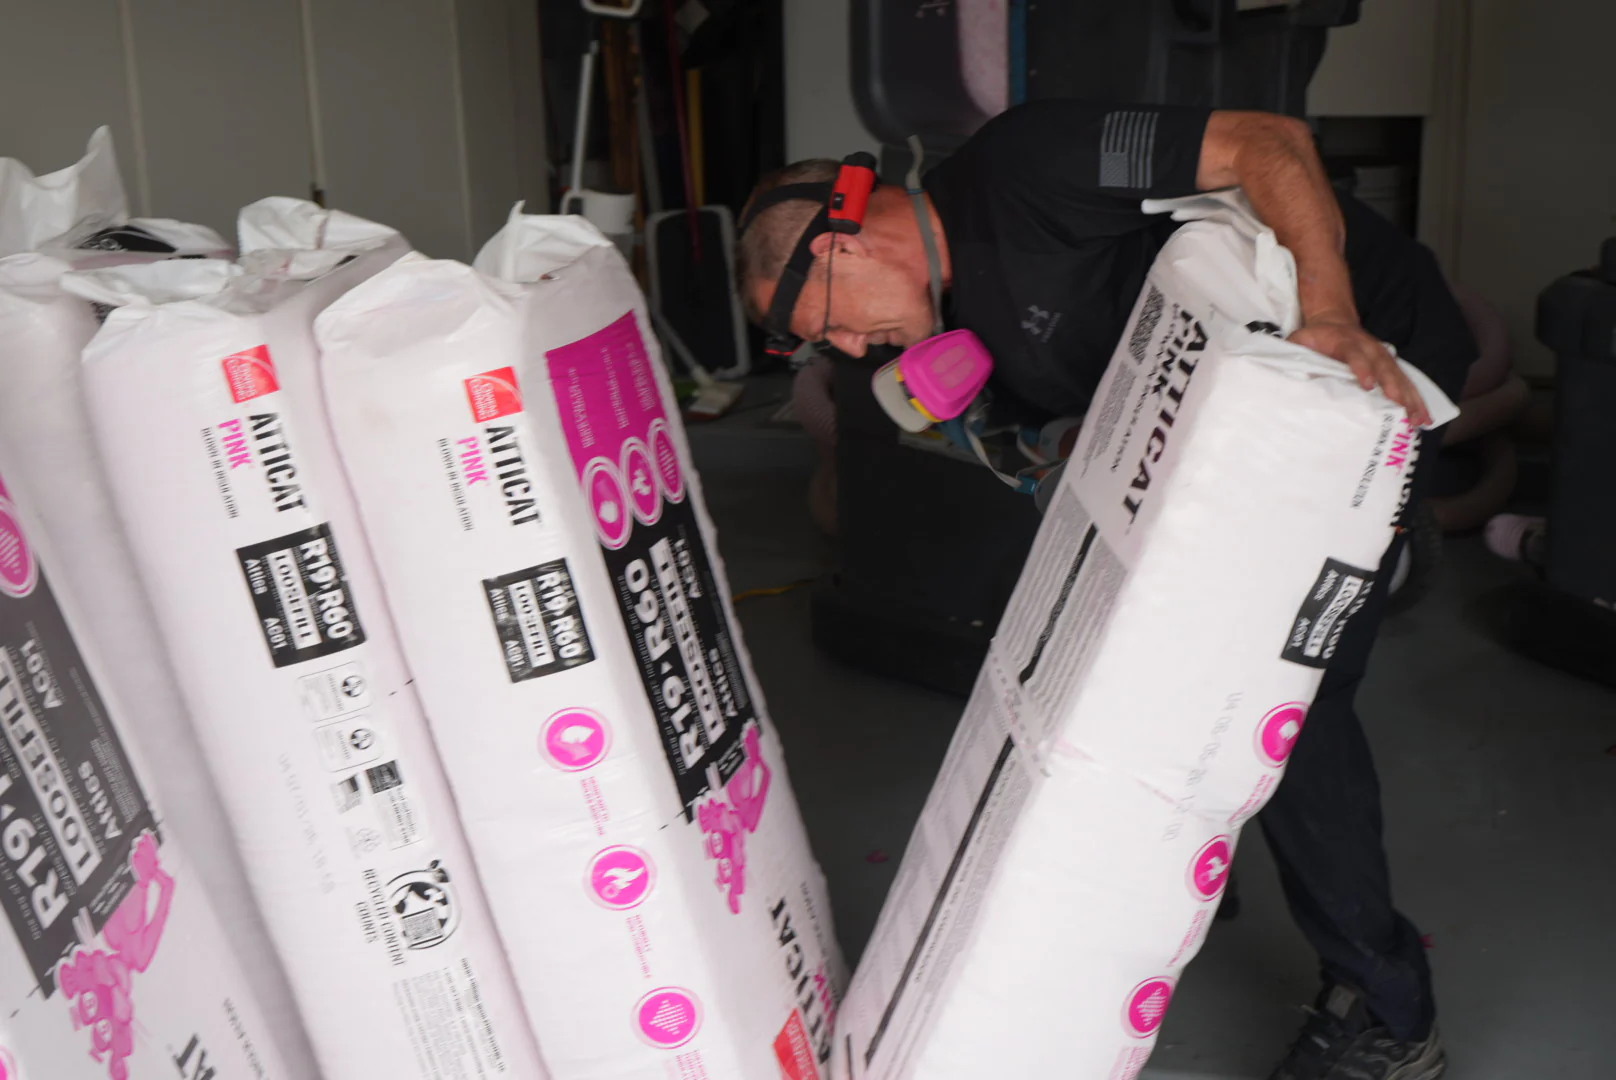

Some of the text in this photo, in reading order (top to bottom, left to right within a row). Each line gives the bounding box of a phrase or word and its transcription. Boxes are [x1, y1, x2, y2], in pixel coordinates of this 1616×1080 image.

[1153, 310, 1194, 394] PINK
[217, 418, 252, 470] PINK
[247, 407, 307, 515] ATTICAT
[455, 436, 488, 486] PINK
[1123, 320, 1208, 524] ATTICAT
[483, 421, 543, 530] ATTICAT
[274, 553, 313, 642] LOOSEFILL
[299, 537, 338, 587] R19
[315, 588, 356, 641] R60
[514, 585, 548, 661] LOOSEFILL
[535, 570, 583, 660] R19 R60
[624, 558, 673, 662] R60
[654, 552, 722, 732] LOOSEFILL
[661, 674, 705, 769] R19
[709, 648, 738, 718] Attics
[0, 655, 95, 878] LOOSEFILL
[77, 760, 122, 840] Attics
[2, 816, 69, 930] R19
[360, 866, 405, 967] RECYCLED CONTENT
[353, 899, 380, 944] COUNTS
[768, 896, 831, 1065] ATTICAT
